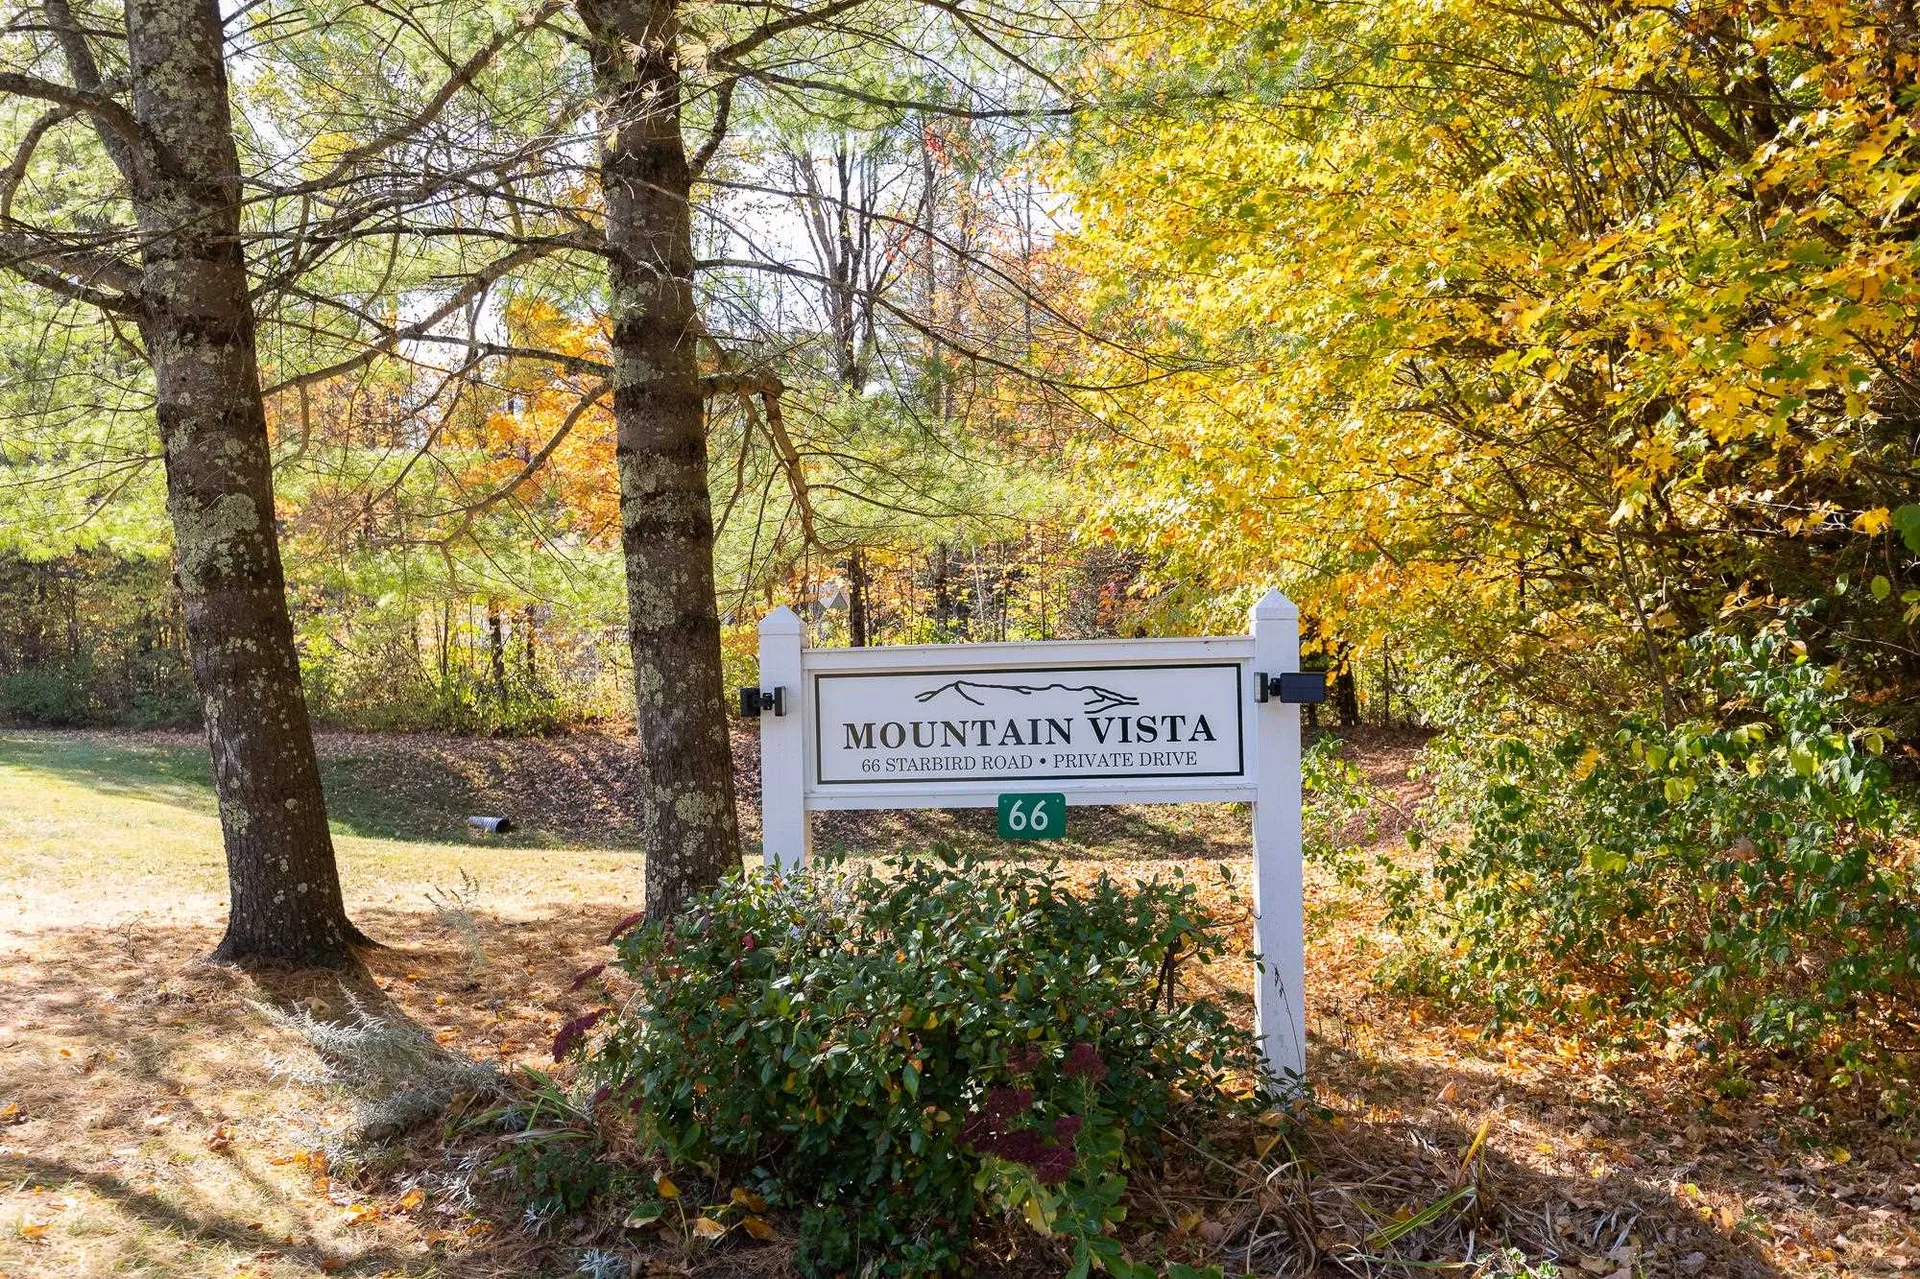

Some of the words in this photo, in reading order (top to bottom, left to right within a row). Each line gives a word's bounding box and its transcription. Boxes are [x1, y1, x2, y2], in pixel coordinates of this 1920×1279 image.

[843, 717, 1072, 750] MOUNTAIN
[1087, 714, 1217, 745] VISTA
[861, 758, 881, 773] 66
[885, 755, 976, 773] STARBIRD
[980, 754, 1033, 771] ROAD
[1053, 752, 1134, 769] PRIVATE
[1139, 750, 1198, 767] DRIVE
[1008, 799, 1049, 831] 66
